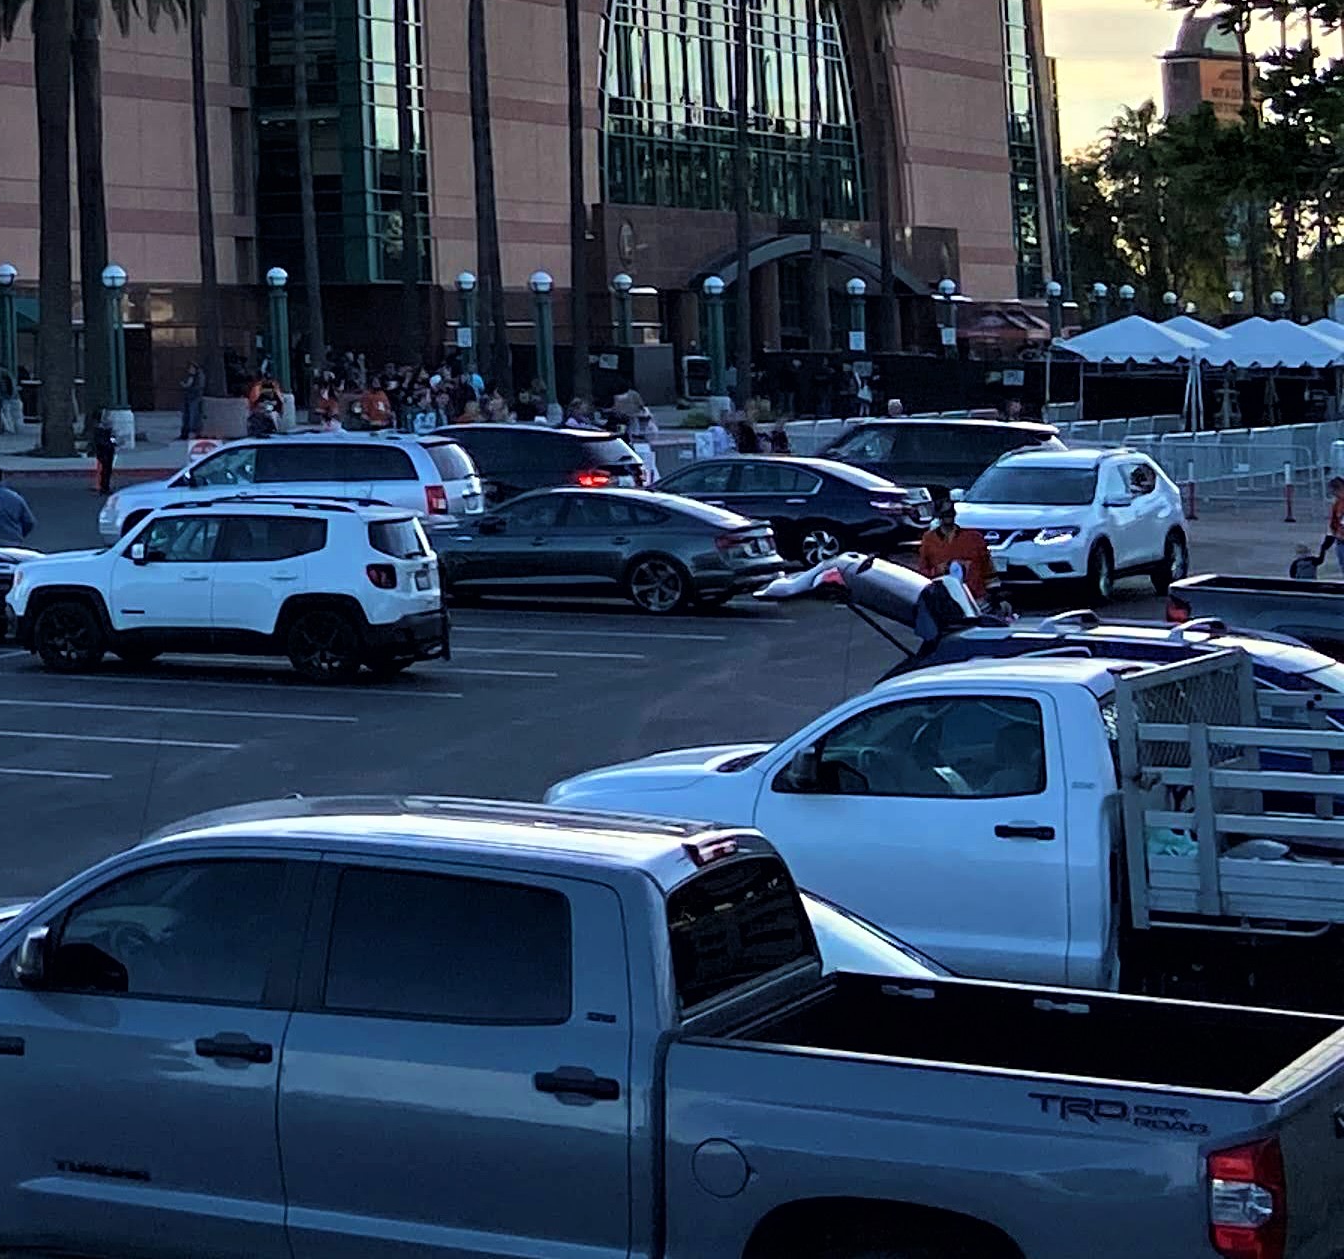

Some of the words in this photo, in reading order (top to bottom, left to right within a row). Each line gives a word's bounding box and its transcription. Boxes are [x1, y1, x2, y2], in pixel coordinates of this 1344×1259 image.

[1027, 1092, 1129, 1125] TRD
[1133, 1104, 1192, 1120] OFF
[1133, 1117, 1211, 1136] ROAD
